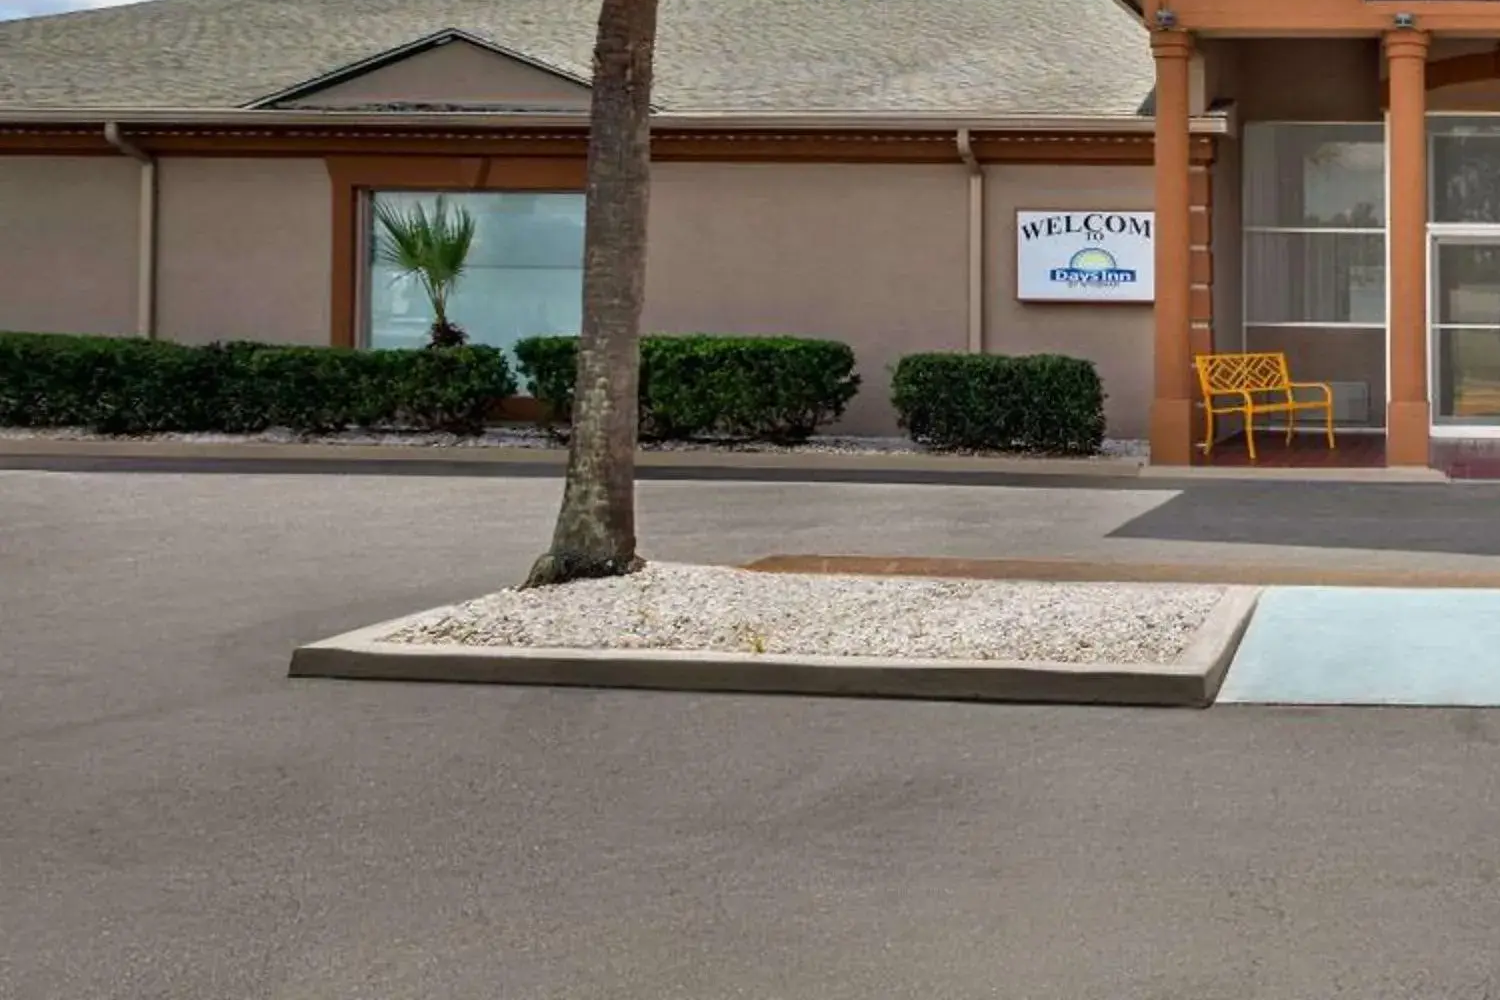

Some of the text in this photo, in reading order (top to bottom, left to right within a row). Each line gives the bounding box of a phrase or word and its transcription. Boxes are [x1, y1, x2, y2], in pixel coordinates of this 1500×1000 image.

[1021, 213, 1152, 242] WELCOM
[1055, 268, 1132, 283] Days Inn
